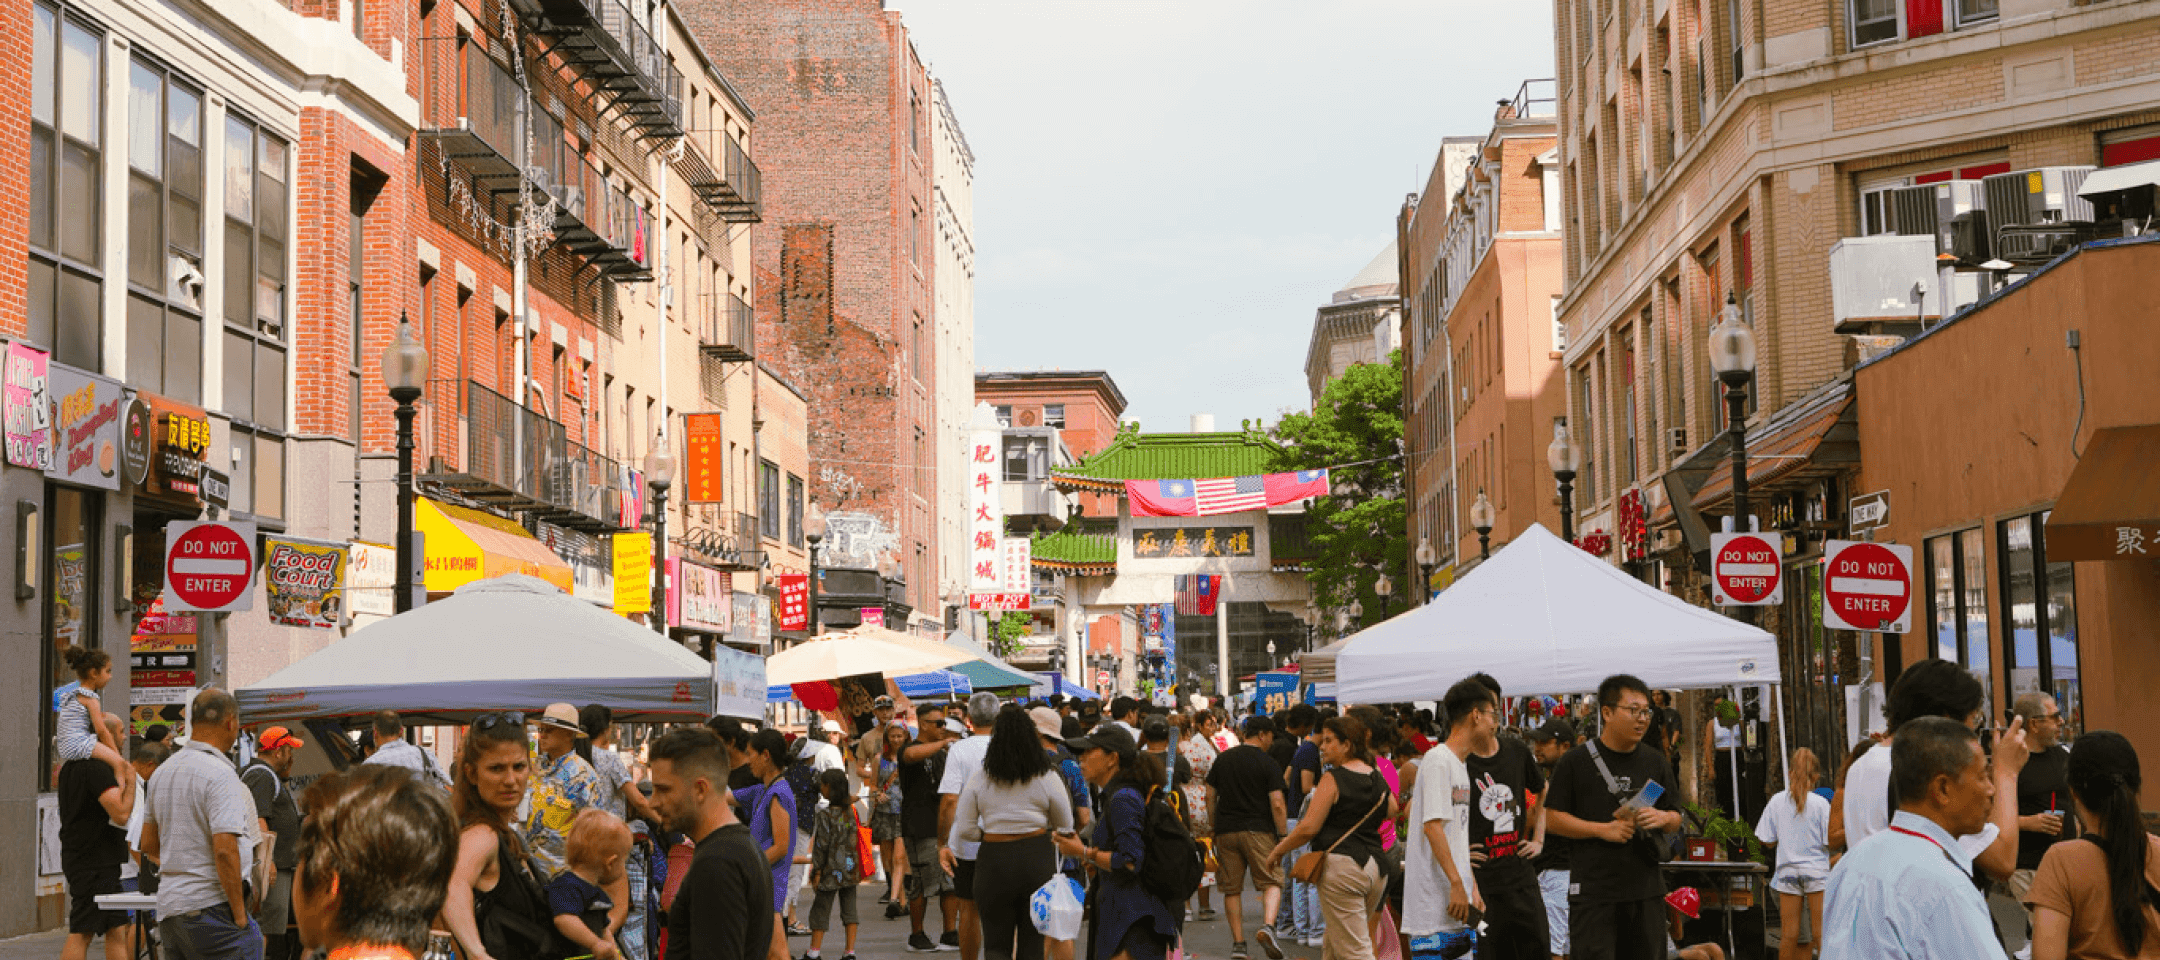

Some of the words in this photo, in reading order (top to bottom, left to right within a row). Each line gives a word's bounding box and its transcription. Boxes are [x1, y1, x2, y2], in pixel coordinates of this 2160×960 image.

[68, 399, 118, 450] Dumpling
[68, 441, 93, 476] King
[974, 444, 996, 581] 肥牛火鍋城
[1854, 506, 1865, 522] ONE
[1867, 503, 1879, 518] WAY
[184, 540, 203, 554] DO
[210, 541, 238, 555] NOT
[273, 547, 337, 572] Food
[1724, 551, 1741, 562] DO
[1747, 551, 1771, 562] NOT
[1840, 560, 1859, 573] DO
[1867, 562, 1894, 575] NOT
[273, 565, 332, 589] Court
[1729, 577, 1766, 588] ENTER
[185, 579, 231, 593] ENTER
[974, 594, 998, 602] HOT
[1004, 593, 1026, 602] POT
[1845, 597, 1890, 612] ENTER
